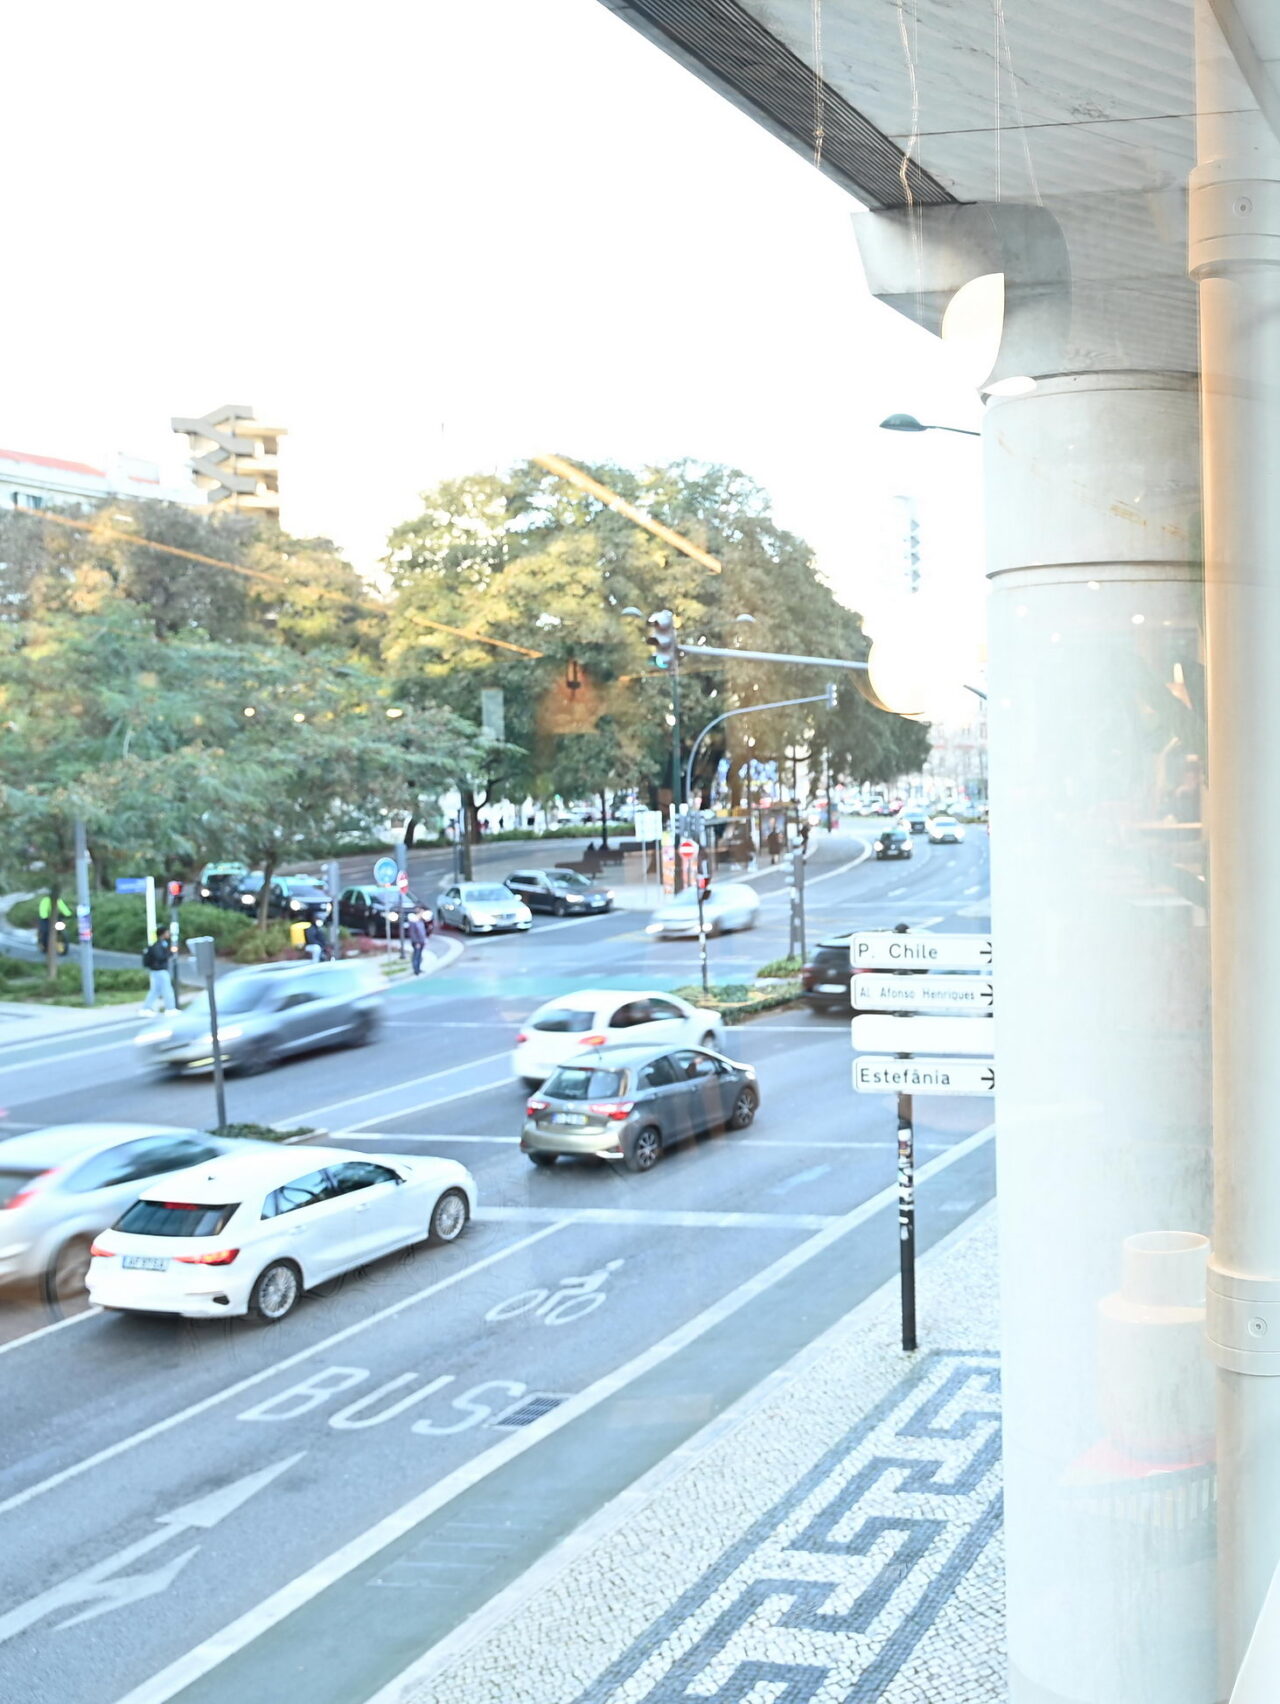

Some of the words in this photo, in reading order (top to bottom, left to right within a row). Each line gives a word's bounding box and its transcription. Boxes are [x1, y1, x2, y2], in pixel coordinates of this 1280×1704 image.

[858, 943, 876, 959] P.
[889, 943, 938, 960] Chile
[880, 986, 915, 999] Afonso
[922, 988, 976, 1001] Henriques
[860, 1067, 951, 1085] Estefânia
[236, 1366, 527, 1435] BUS
